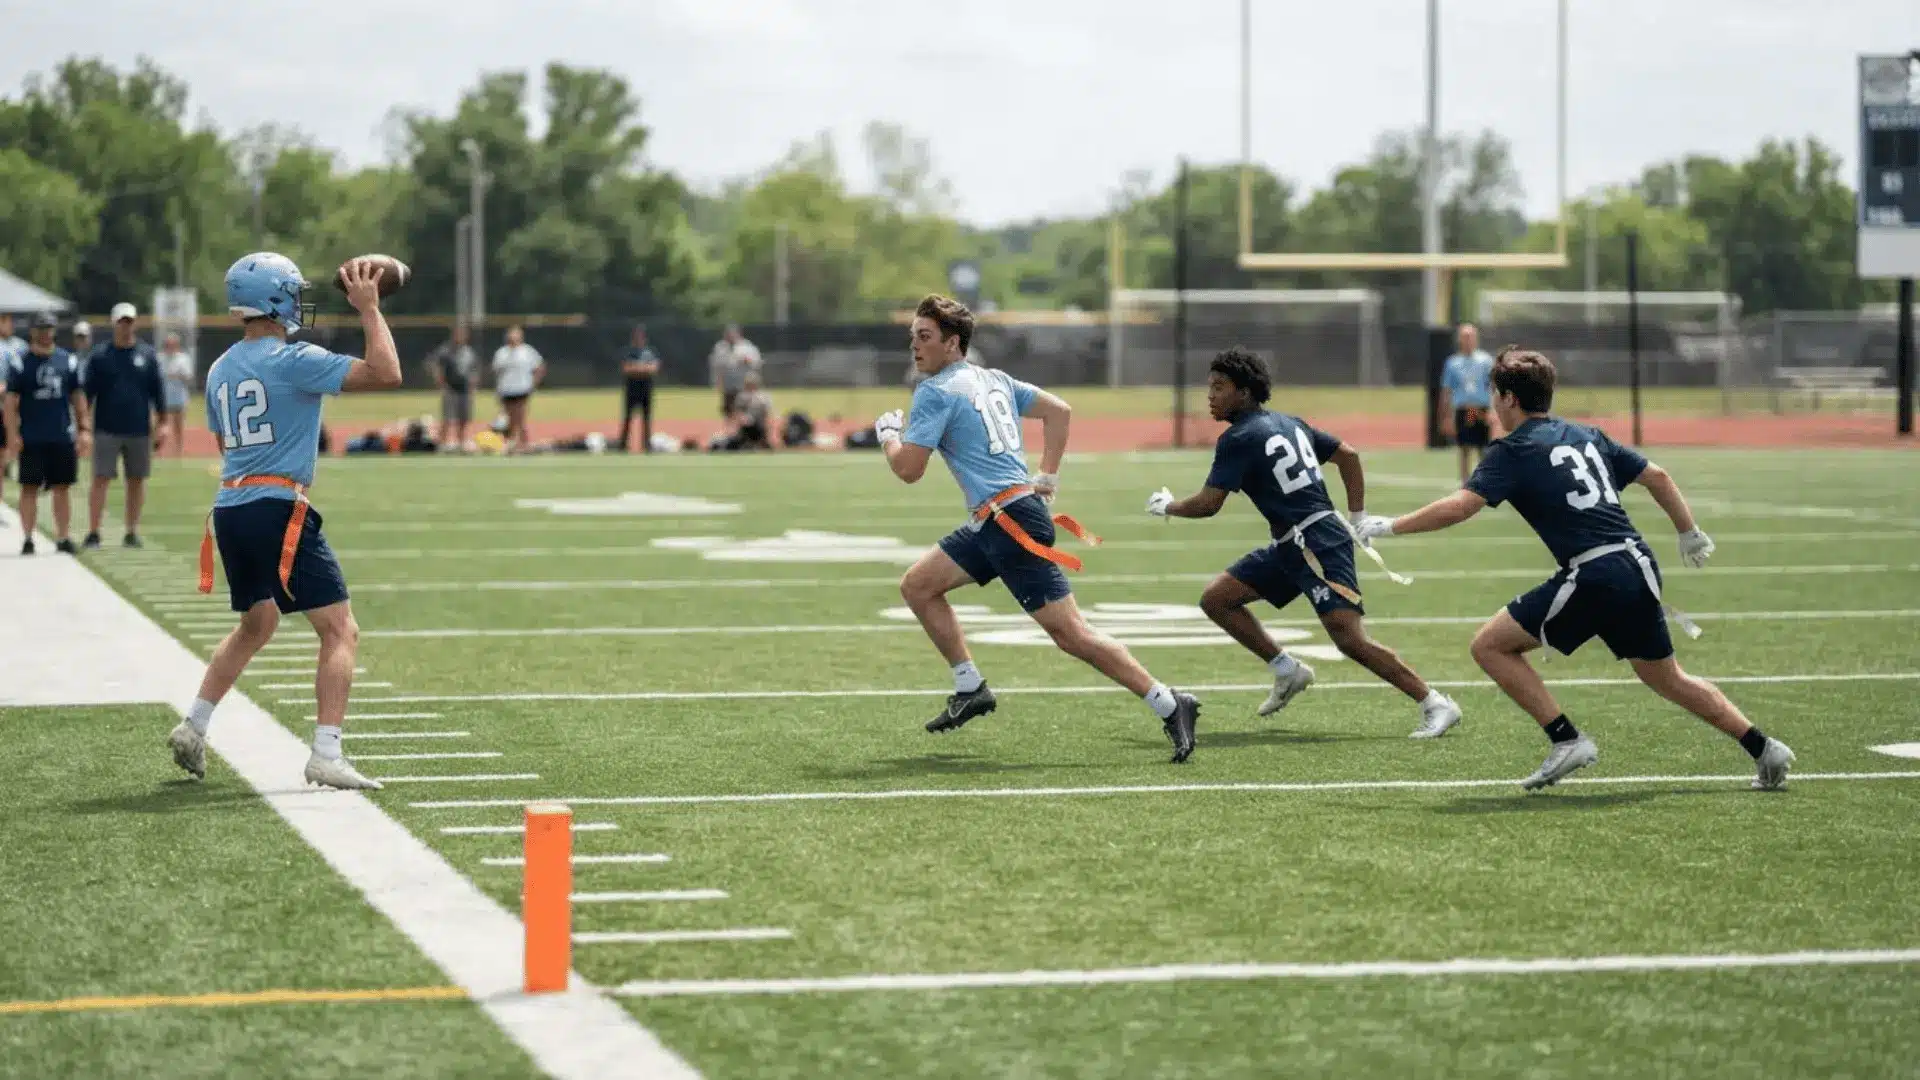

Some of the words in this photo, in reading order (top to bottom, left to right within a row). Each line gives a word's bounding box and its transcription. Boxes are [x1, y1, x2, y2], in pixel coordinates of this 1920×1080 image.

[217, 379, 274, 448] 12
[975, 390, 1020, 454] 18
[1265, 425, 1323, 494] 24
[1550, 441, 1619, 510] 31
